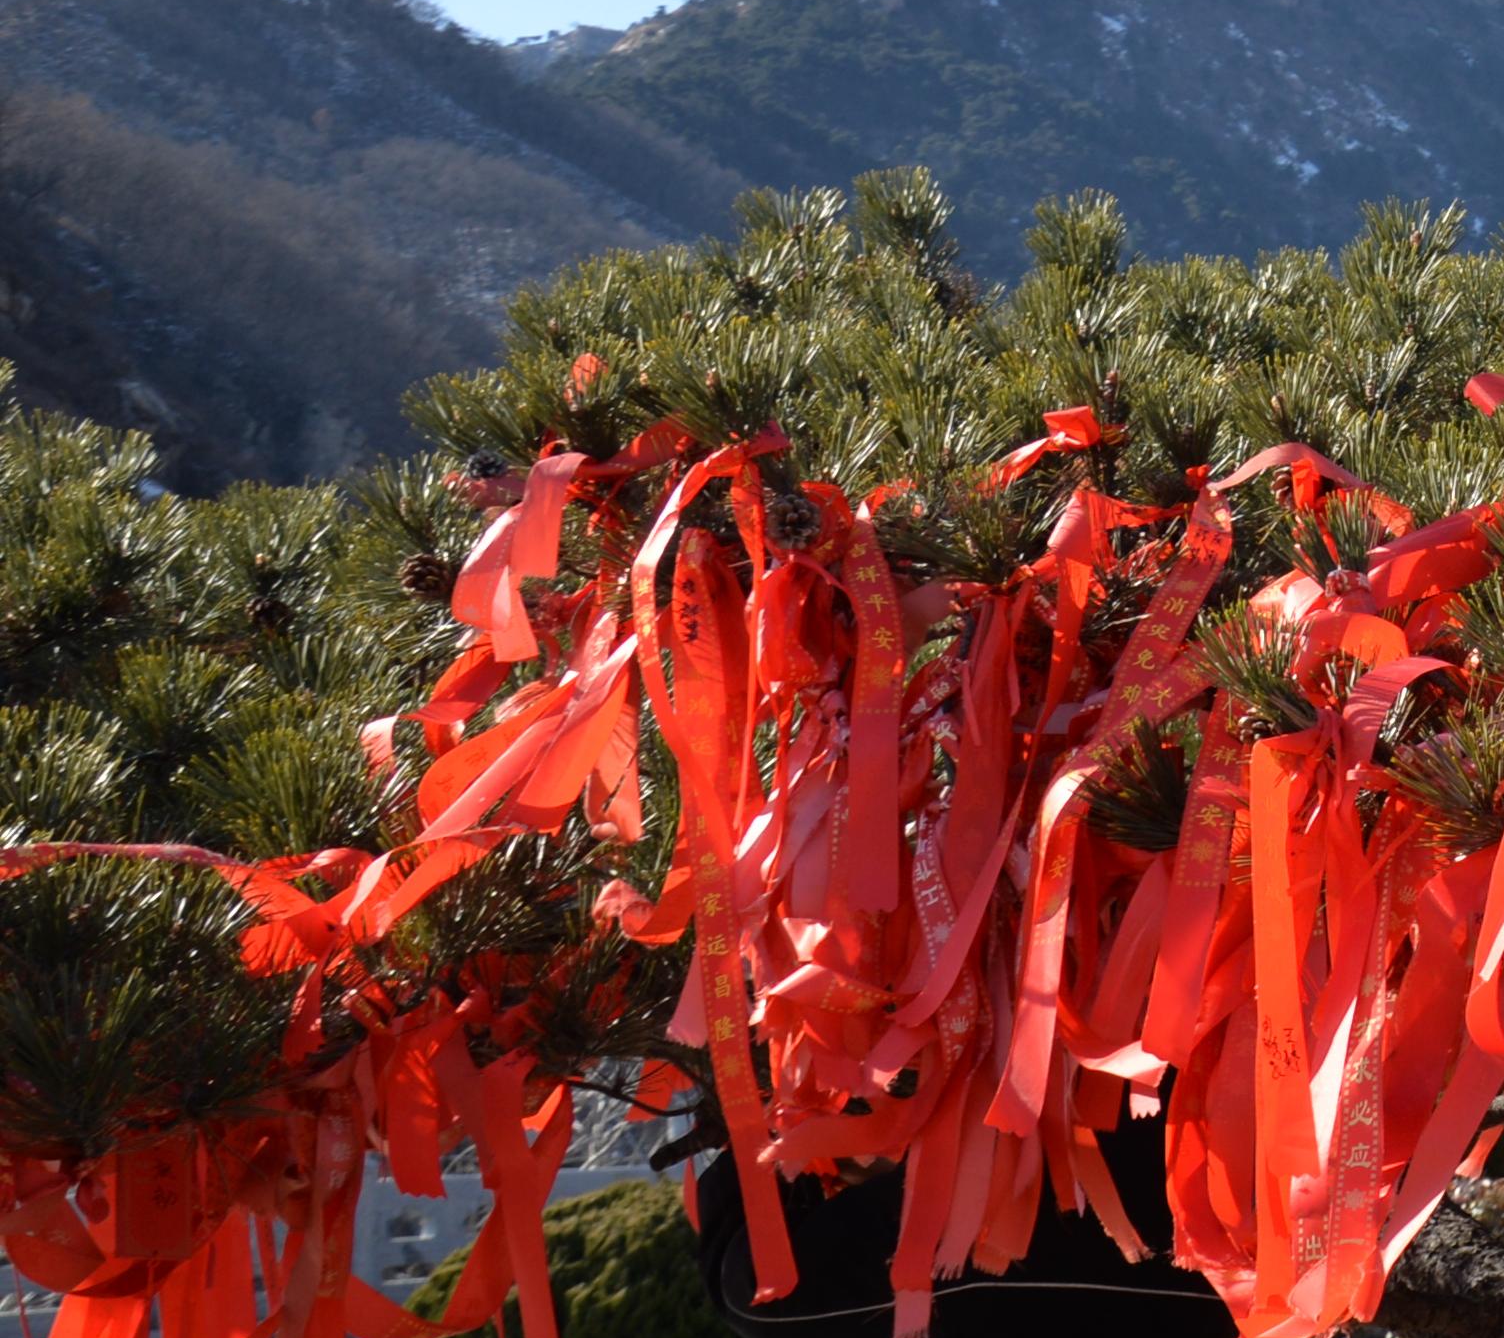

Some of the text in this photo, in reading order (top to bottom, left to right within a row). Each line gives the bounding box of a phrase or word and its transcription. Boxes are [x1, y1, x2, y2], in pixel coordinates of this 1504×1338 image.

[850, 541, 896, 651] 吉祥平安
[1120, 595, 1189, 706] 消灾免难
[701, 892, 738, 1042] 家运昌隆
